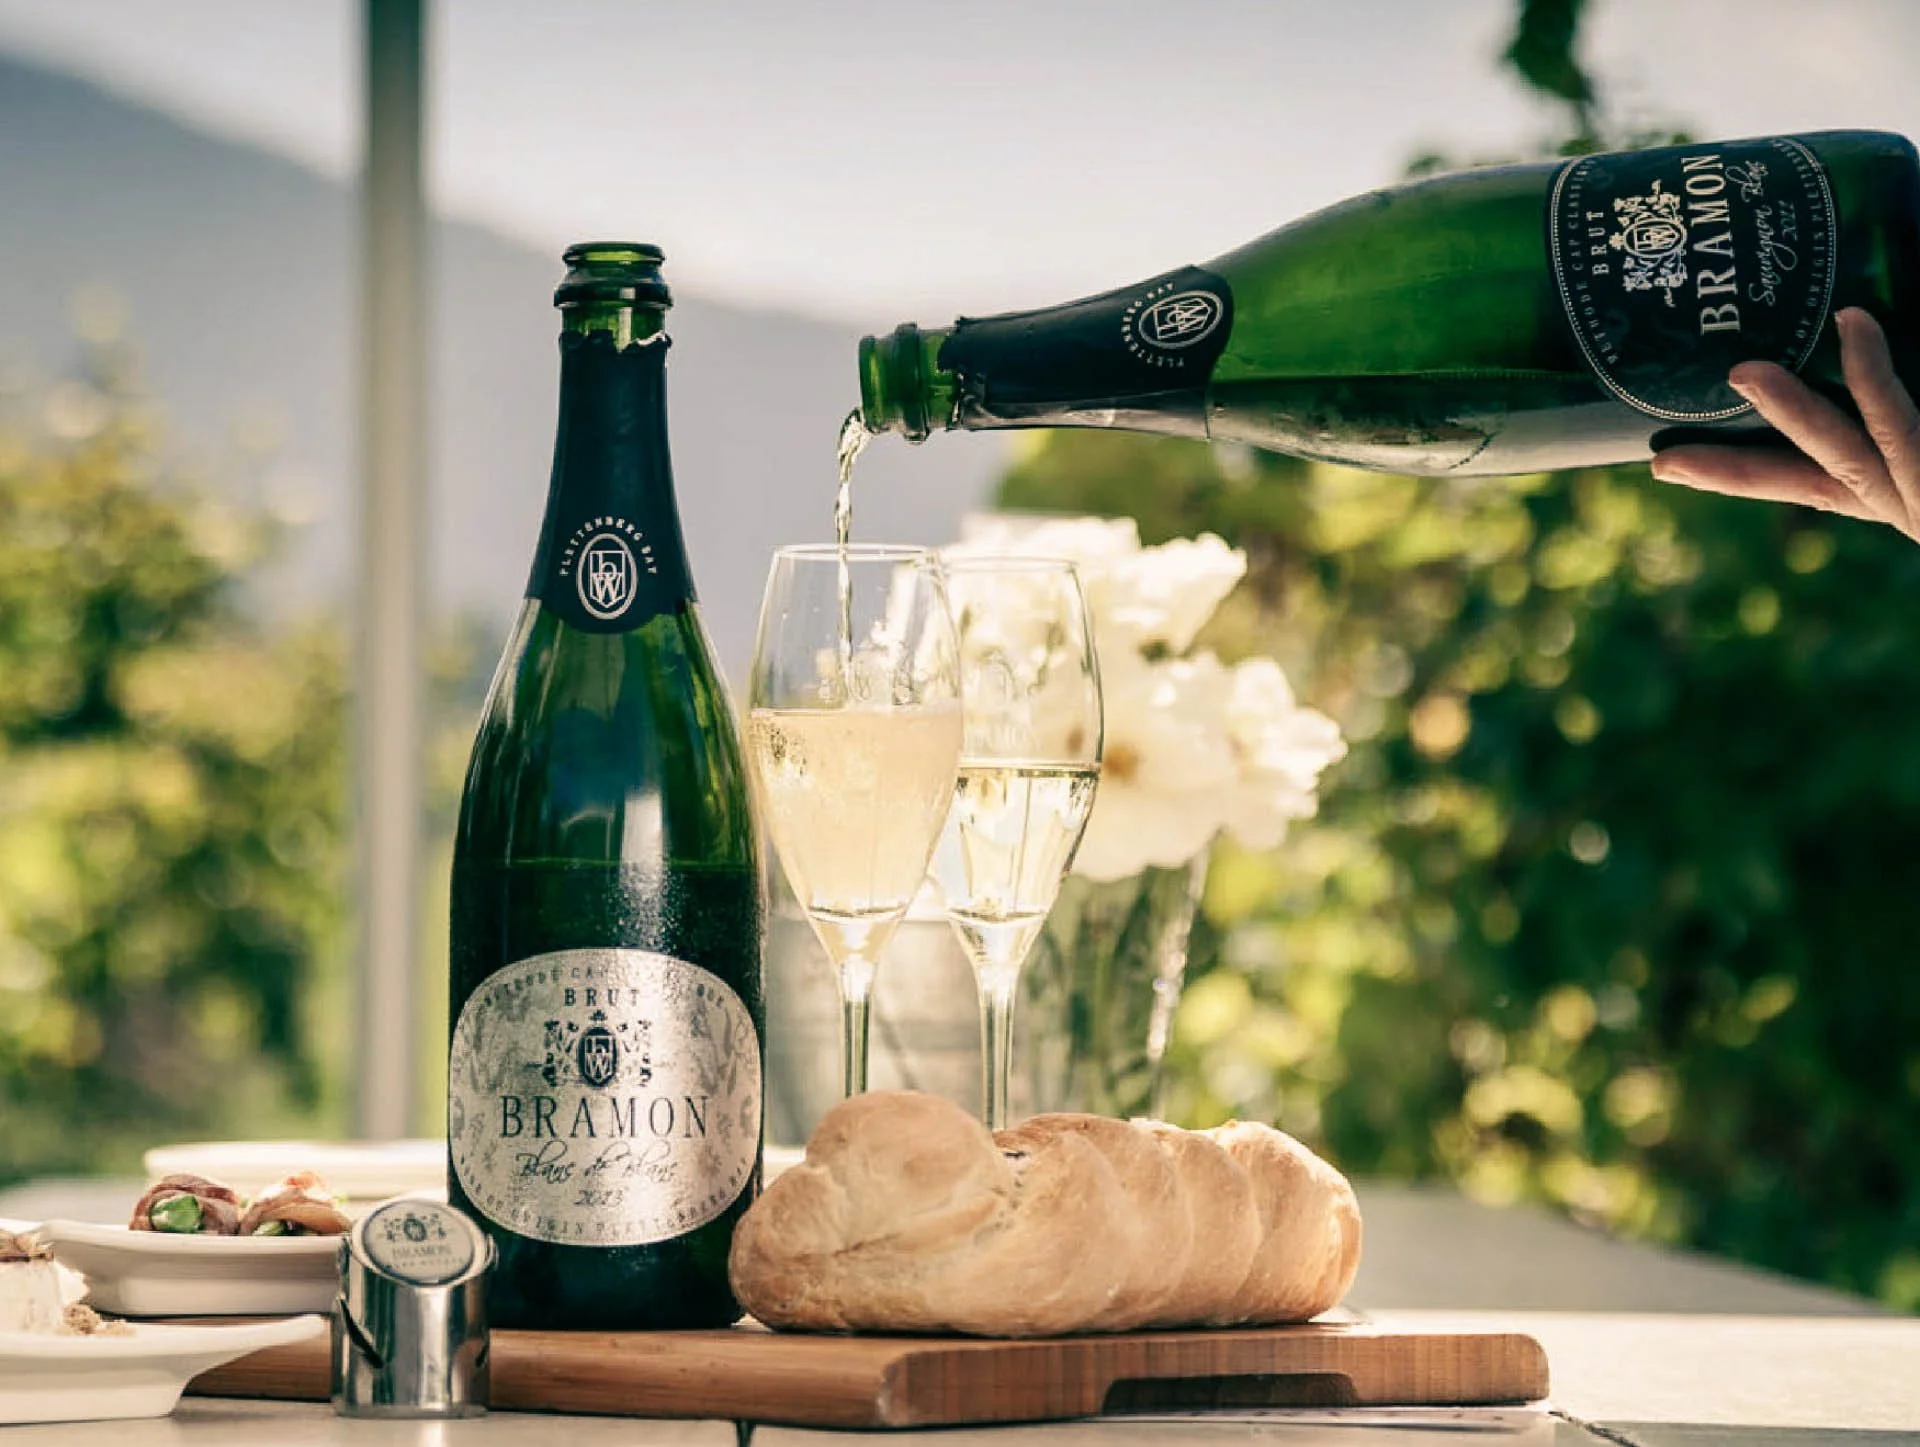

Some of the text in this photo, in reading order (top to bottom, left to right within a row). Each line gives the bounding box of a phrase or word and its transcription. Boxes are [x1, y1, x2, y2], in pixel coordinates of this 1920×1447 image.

[1585, 209, 1611, 276] BRUT
[1681, 154, 1741, 335] BRAMON
[563, 988, 641, 1007] BRUT
[500, 1094, 712, 1138] BRAMON
